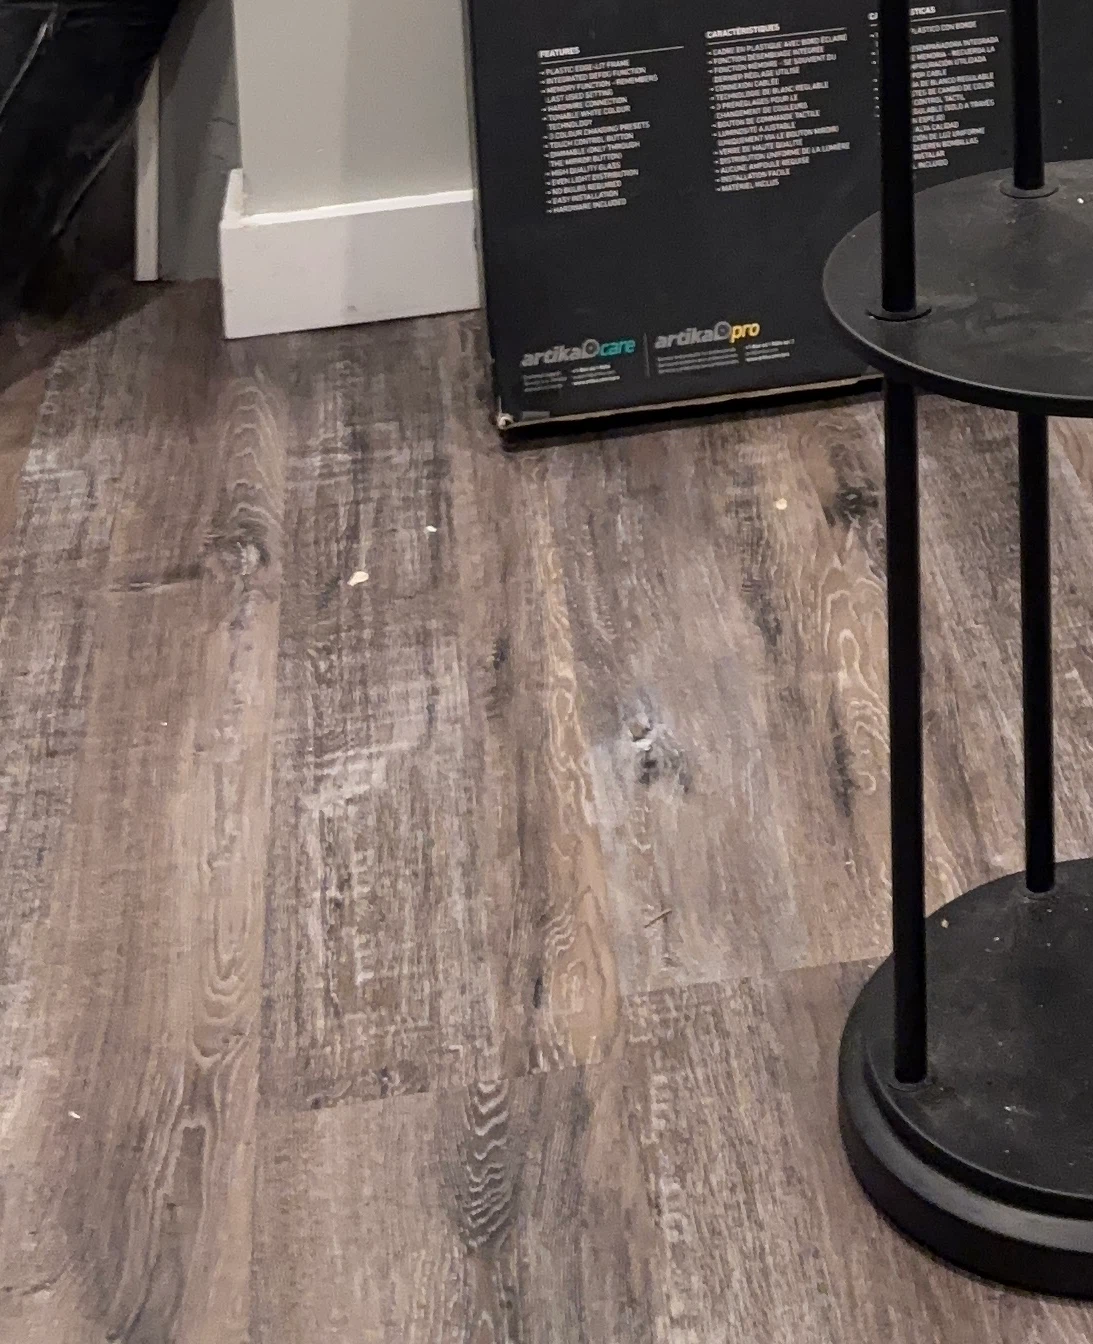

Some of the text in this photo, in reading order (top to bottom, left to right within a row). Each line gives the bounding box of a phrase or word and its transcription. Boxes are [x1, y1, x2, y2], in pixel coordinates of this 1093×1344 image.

[538, 46, 580, 58] FEATURES
[655, 322, 760, 349] artika pro
[600, 339, 636, 357] care
